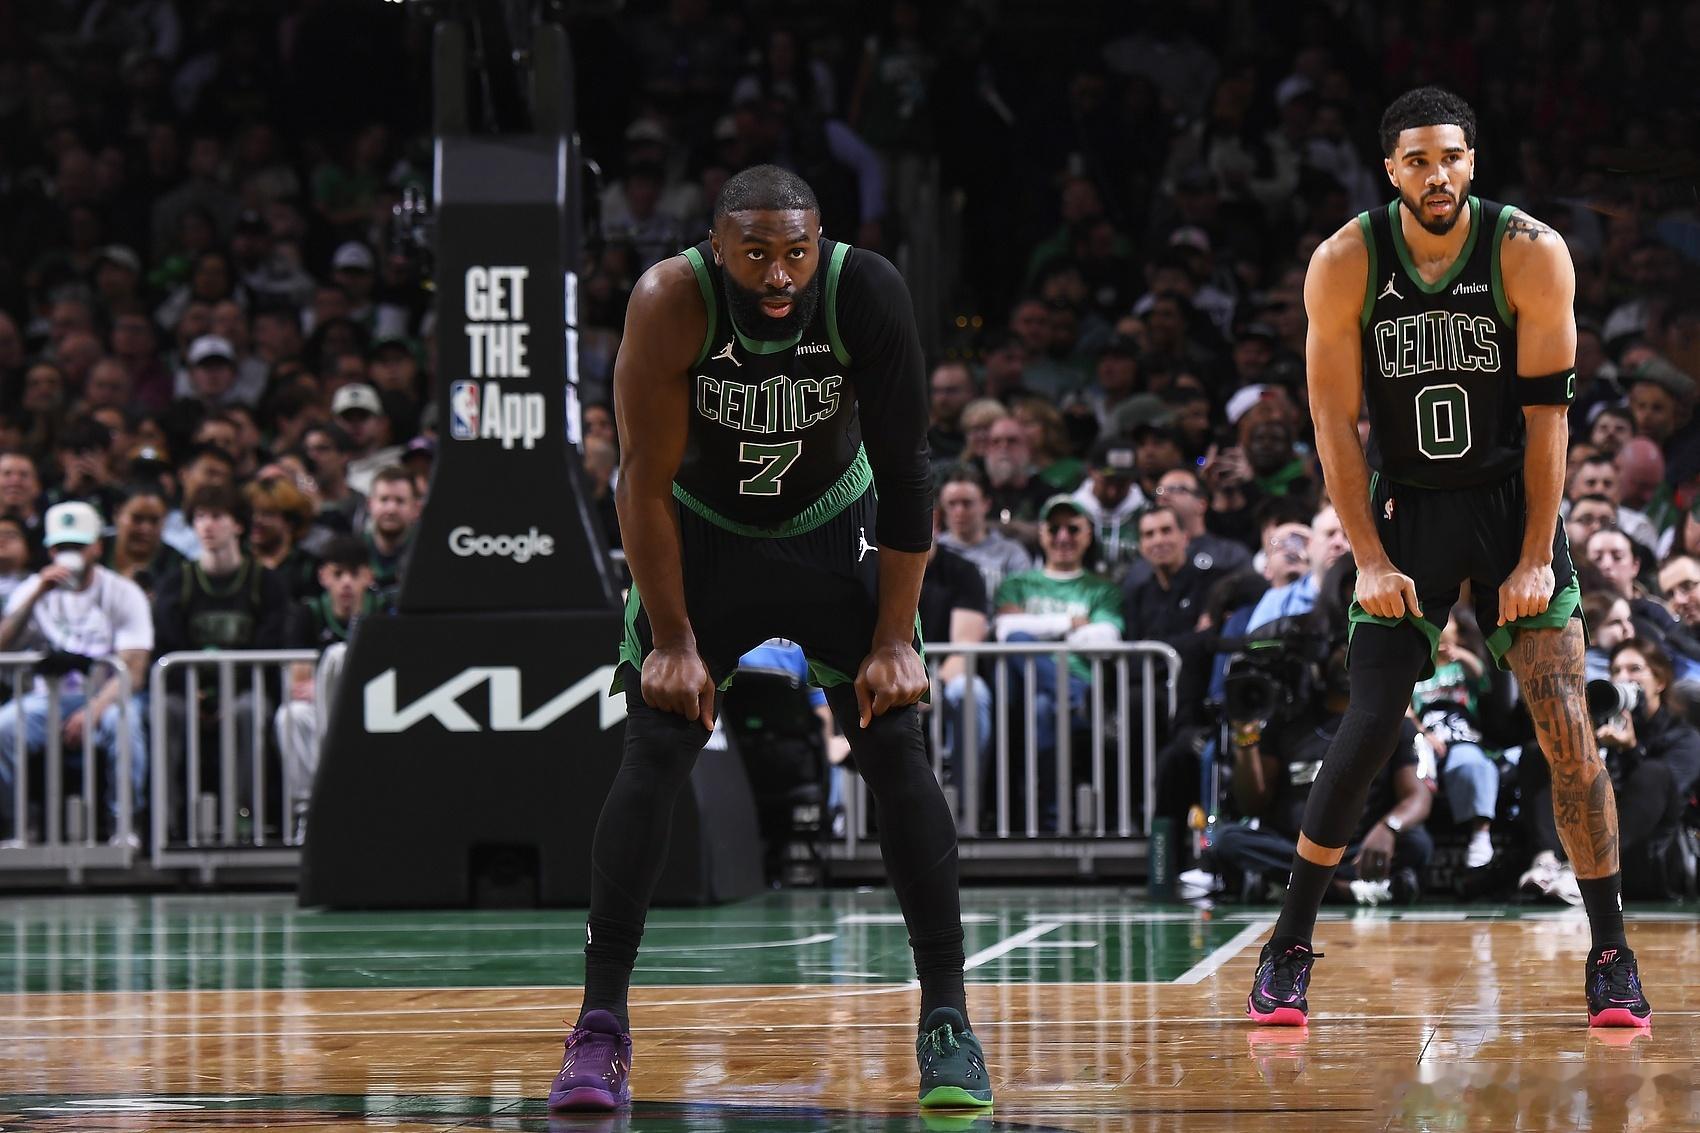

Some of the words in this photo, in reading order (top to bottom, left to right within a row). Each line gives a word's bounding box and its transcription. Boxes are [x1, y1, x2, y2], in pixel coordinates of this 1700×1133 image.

[465, 266, 529, 321] GET
[1452, 282, 1488, 296] Amica
[465, 324, 530, 378] THE
[1375, 310, 1501, 378] CELTICS
[481, 382, 546, 449] App
[697, 375, 842, 433] CELTICS
[1415, 383, 1472, 460] 0
[739, 440, 802, 496] 7
[449, 526, 555, 563] Google
[364, 665, 629, 733] KIA
